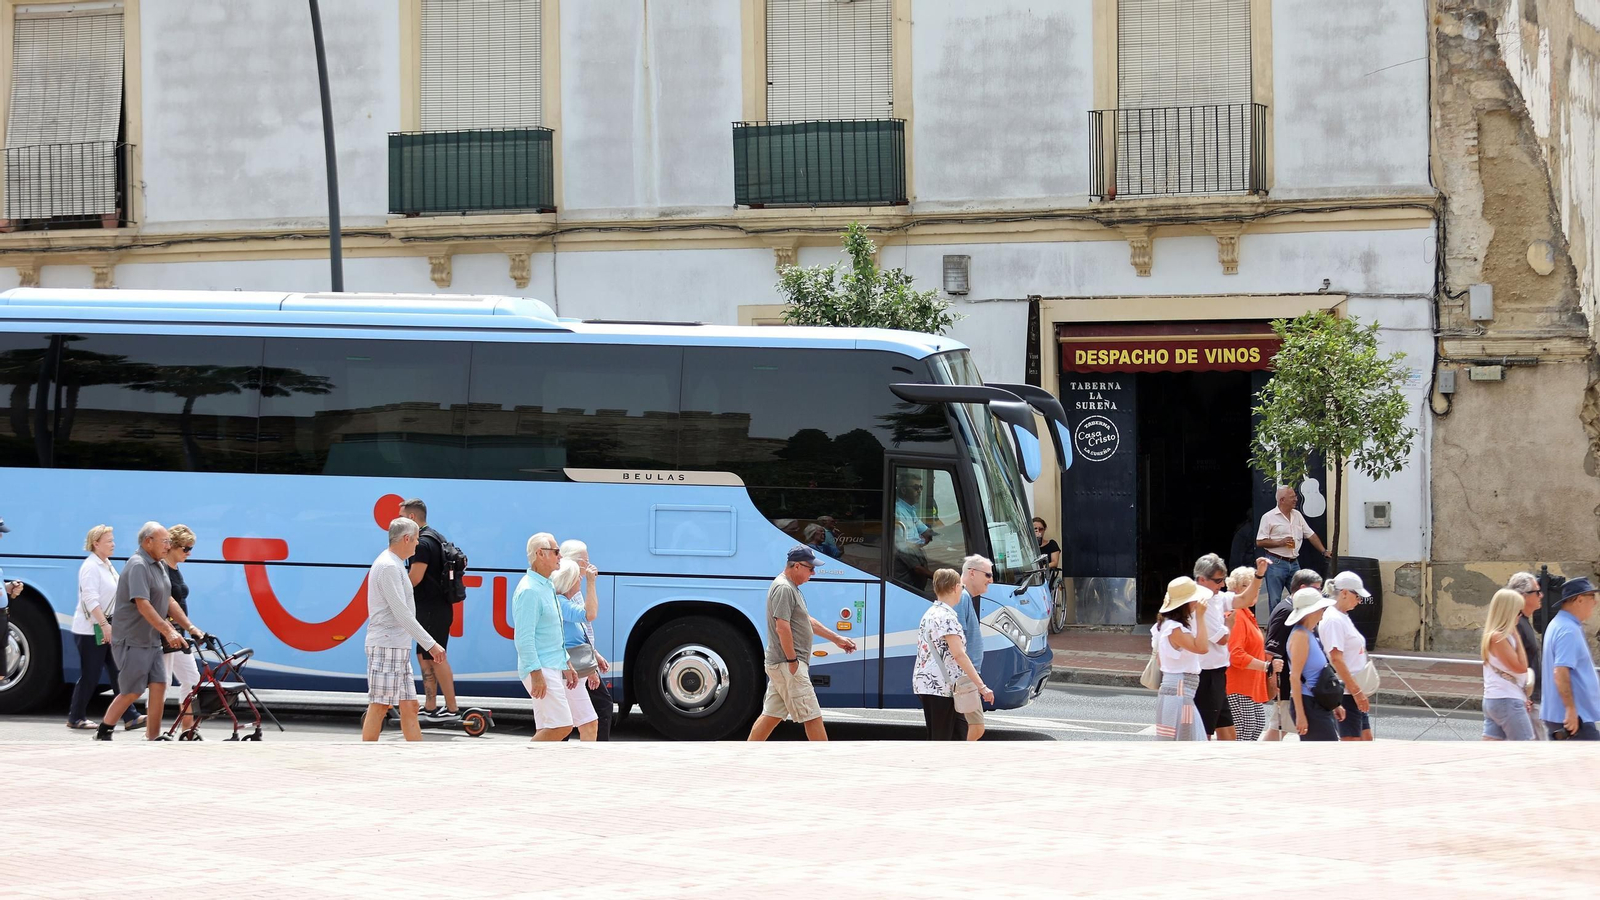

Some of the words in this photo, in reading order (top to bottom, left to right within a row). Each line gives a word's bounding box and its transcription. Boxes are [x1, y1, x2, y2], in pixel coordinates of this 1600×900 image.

[1075, 349, 1169, 365] DESPACHO
[1175, 348, 1198, 364] DE
[1204, 347, 1261, 364] VINOS
[1070, 382, 1121, 390] TABERNA
[1075, 399, 1117, 410] SUREÑA
[1084, 420, 1111, 430] TABERNA
[1078, 431, 1102, 440] Casa
[1088, 434, 1116, 447] Cristo
[622, 472, 685, 481] BEULAS
[834, 533, 864, 546] ygnus
